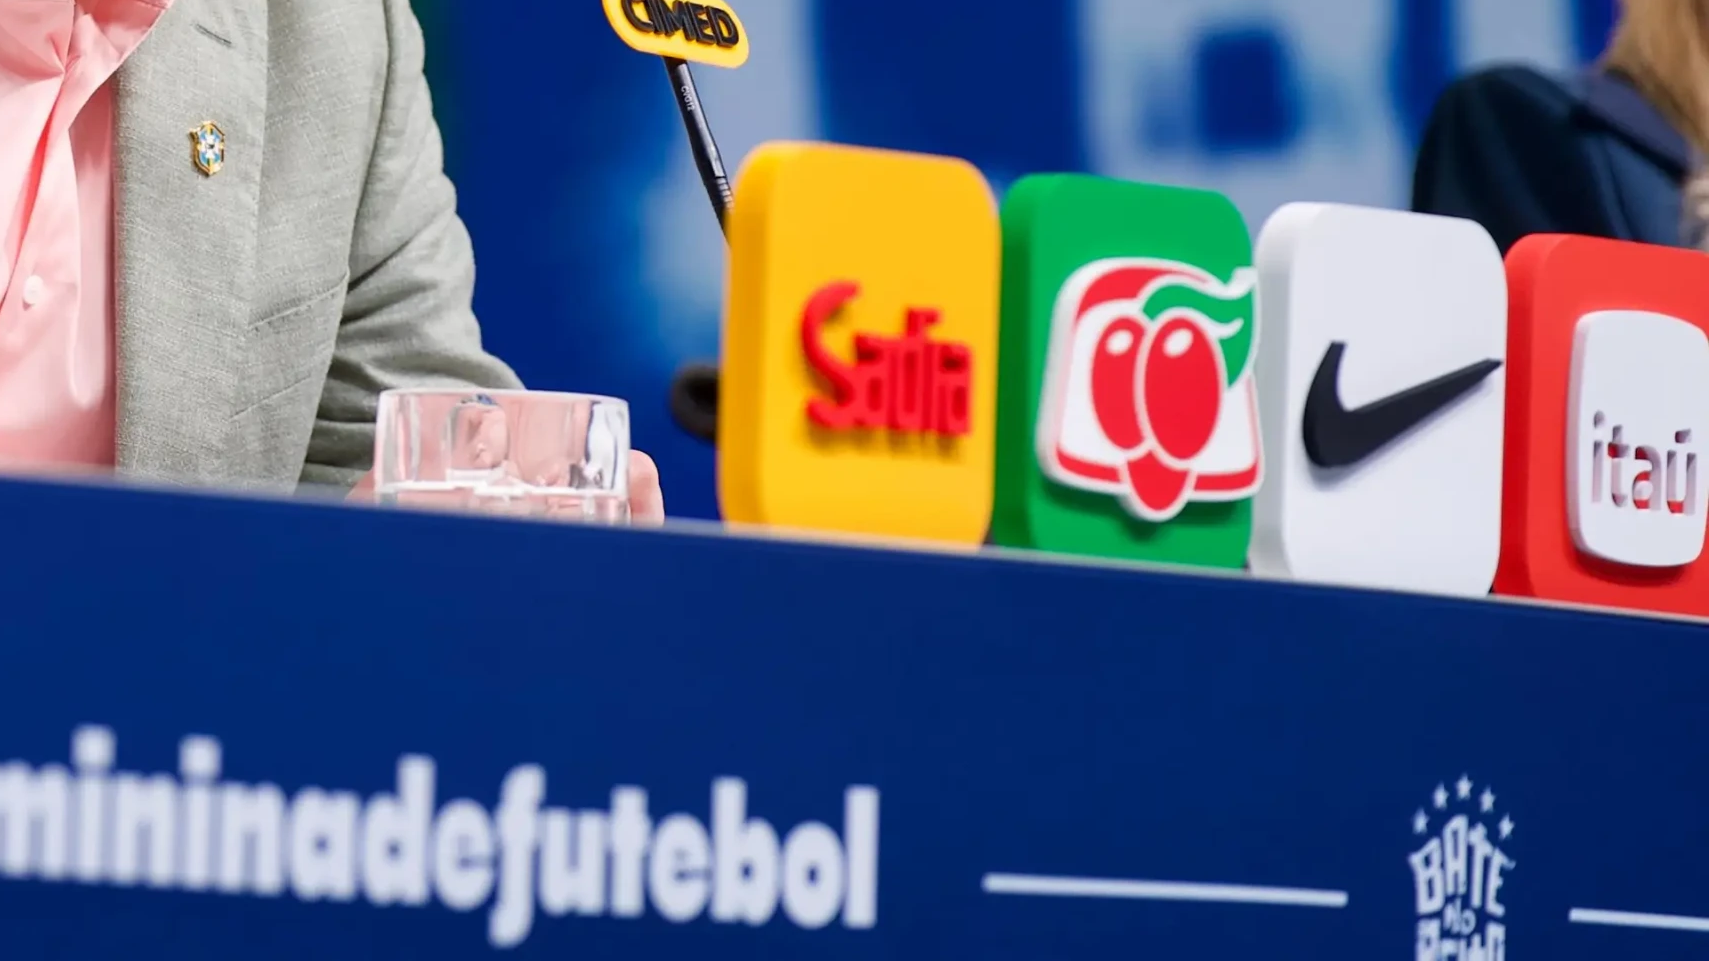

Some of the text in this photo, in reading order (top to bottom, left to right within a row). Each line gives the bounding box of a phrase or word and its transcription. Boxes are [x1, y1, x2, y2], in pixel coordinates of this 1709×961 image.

[800, 280, 973, 436] Sadia
[1592, 410, 1697, 516] itaú
[1407, 814, 1516, 917] BATE
